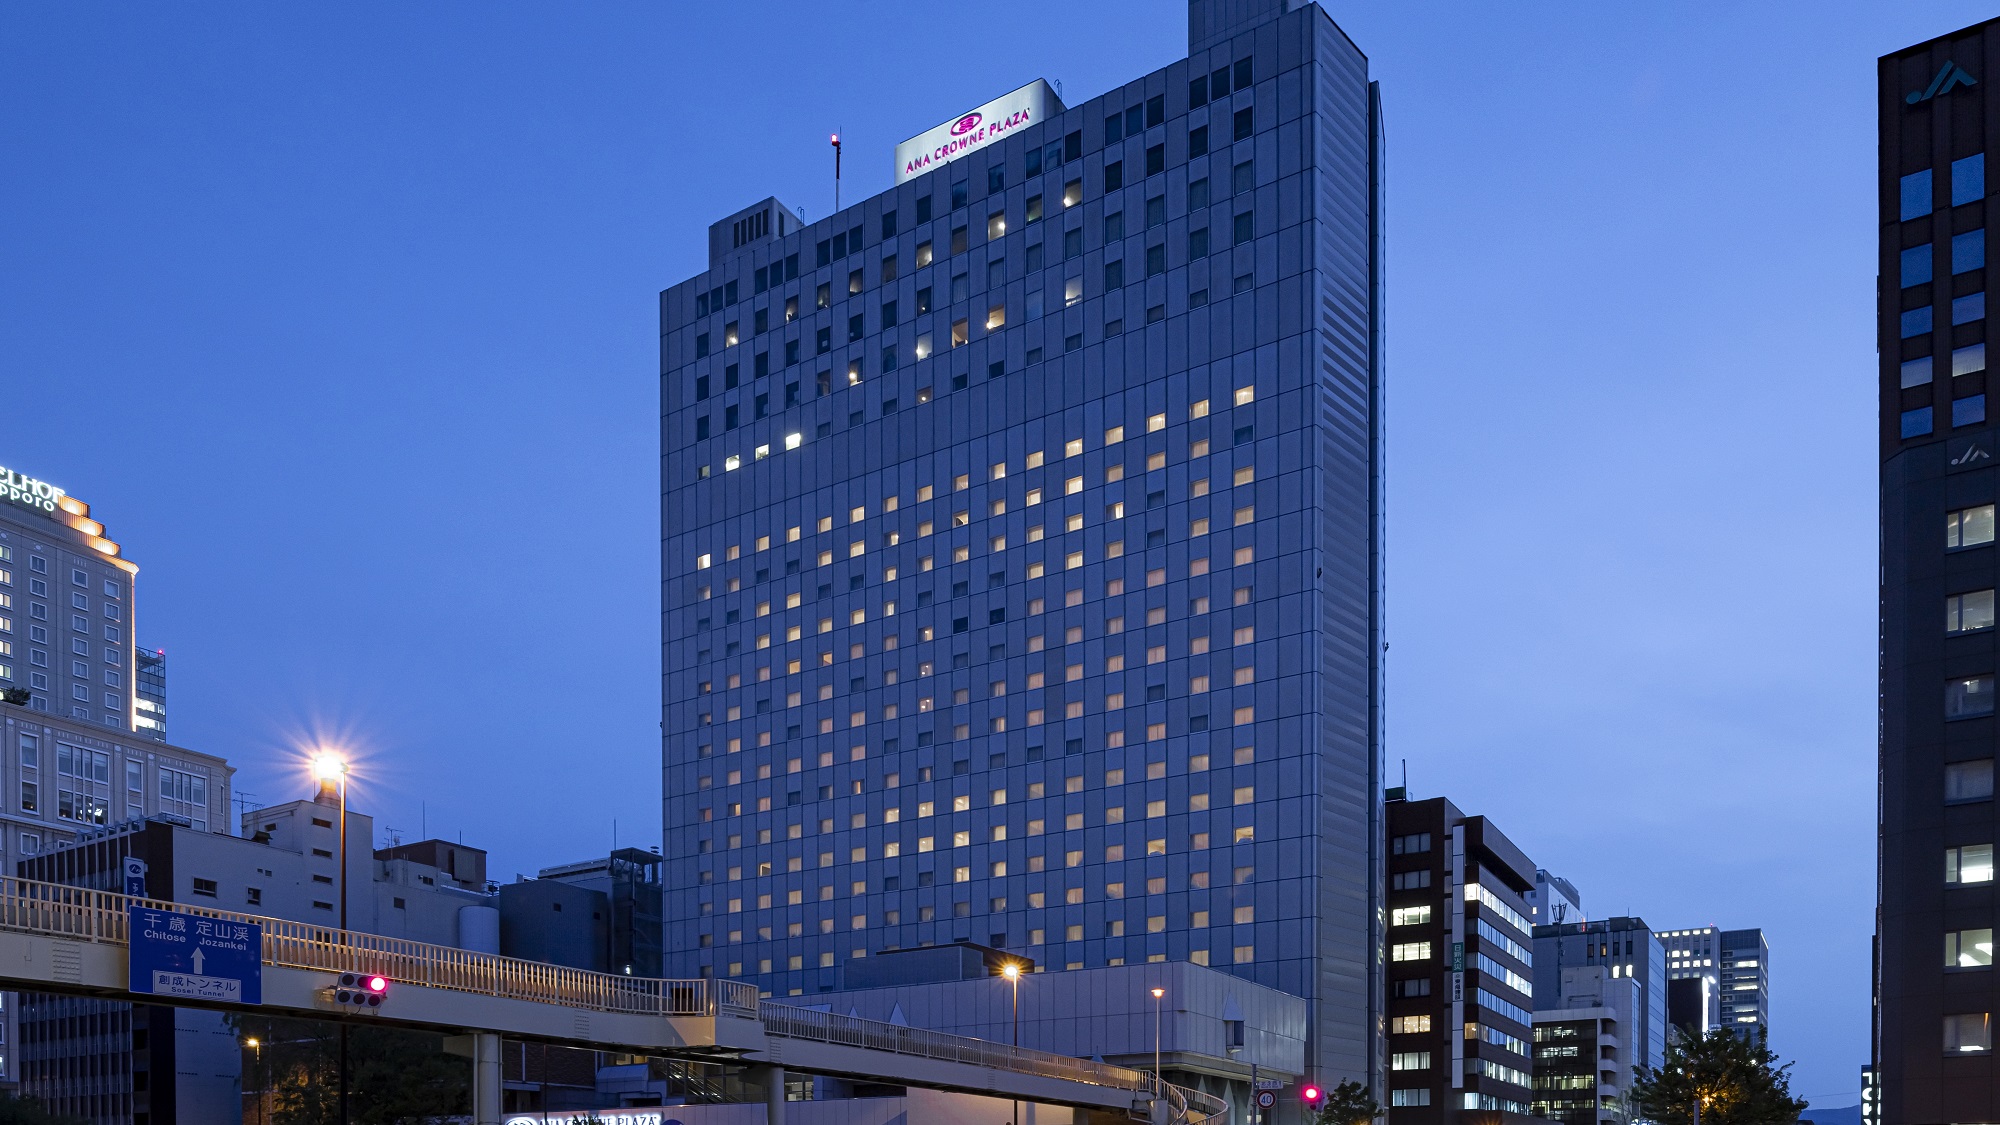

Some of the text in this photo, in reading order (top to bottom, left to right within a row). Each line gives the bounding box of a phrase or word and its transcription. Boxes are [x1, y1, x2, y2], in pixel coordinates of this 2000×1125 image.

[905, 108, 1030, 174] ANA CROWNE PLAZA
[144, 912, 249, 942] 千歳 定山渓
[144, 930, 247, 951] Chitose Jozankei
[159, 974, 236, 992] 創成トンネル
[171, 986, 224, 997] Sosei Tunnel
[1261, 1095, 1272, 1104] 40
